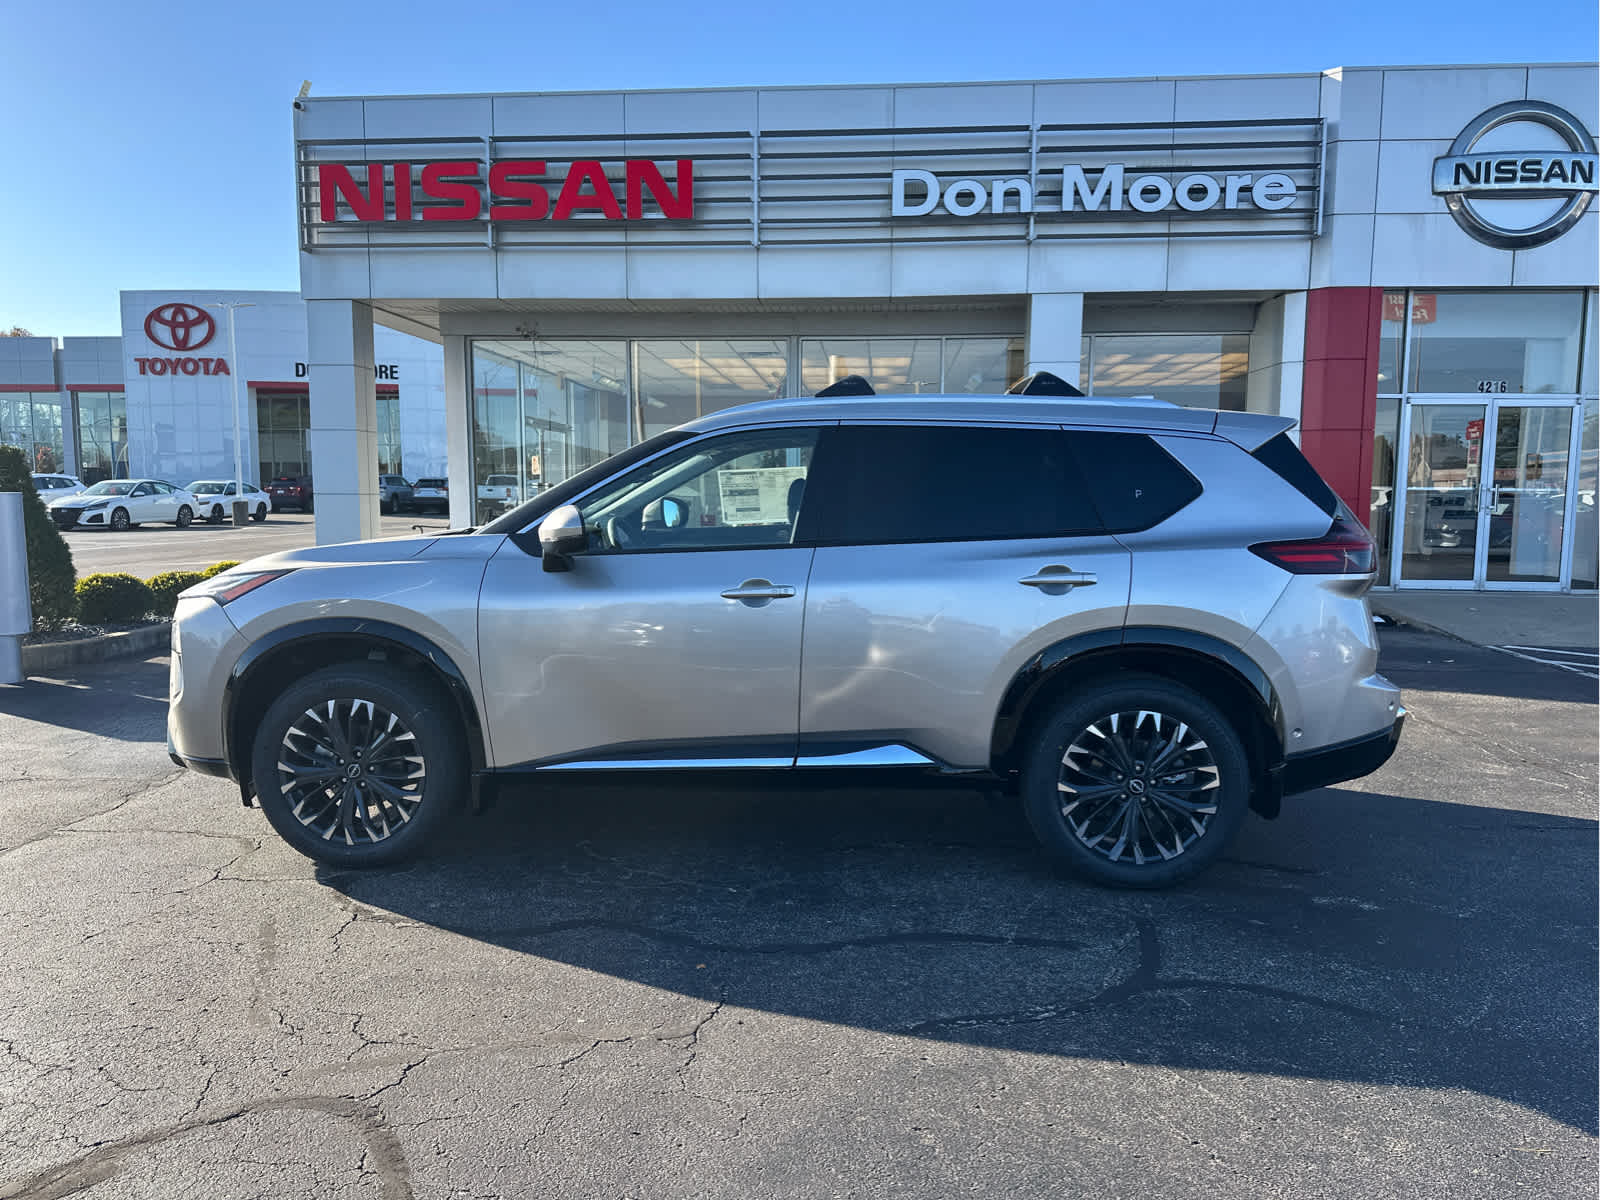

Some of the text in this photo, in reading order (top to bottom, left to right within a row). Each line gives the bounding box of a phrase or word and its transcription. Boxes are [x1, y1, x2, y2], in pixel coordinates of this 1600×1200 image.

[1453, 158, 1595, 186] NISSAN
[318, 159, 694, 222] NISSAN
[891, 163, 1298, 217] Don Moore
[134, 357, 231, 376] TOYOTA
[1478, 381, 1507, 393] 4216
